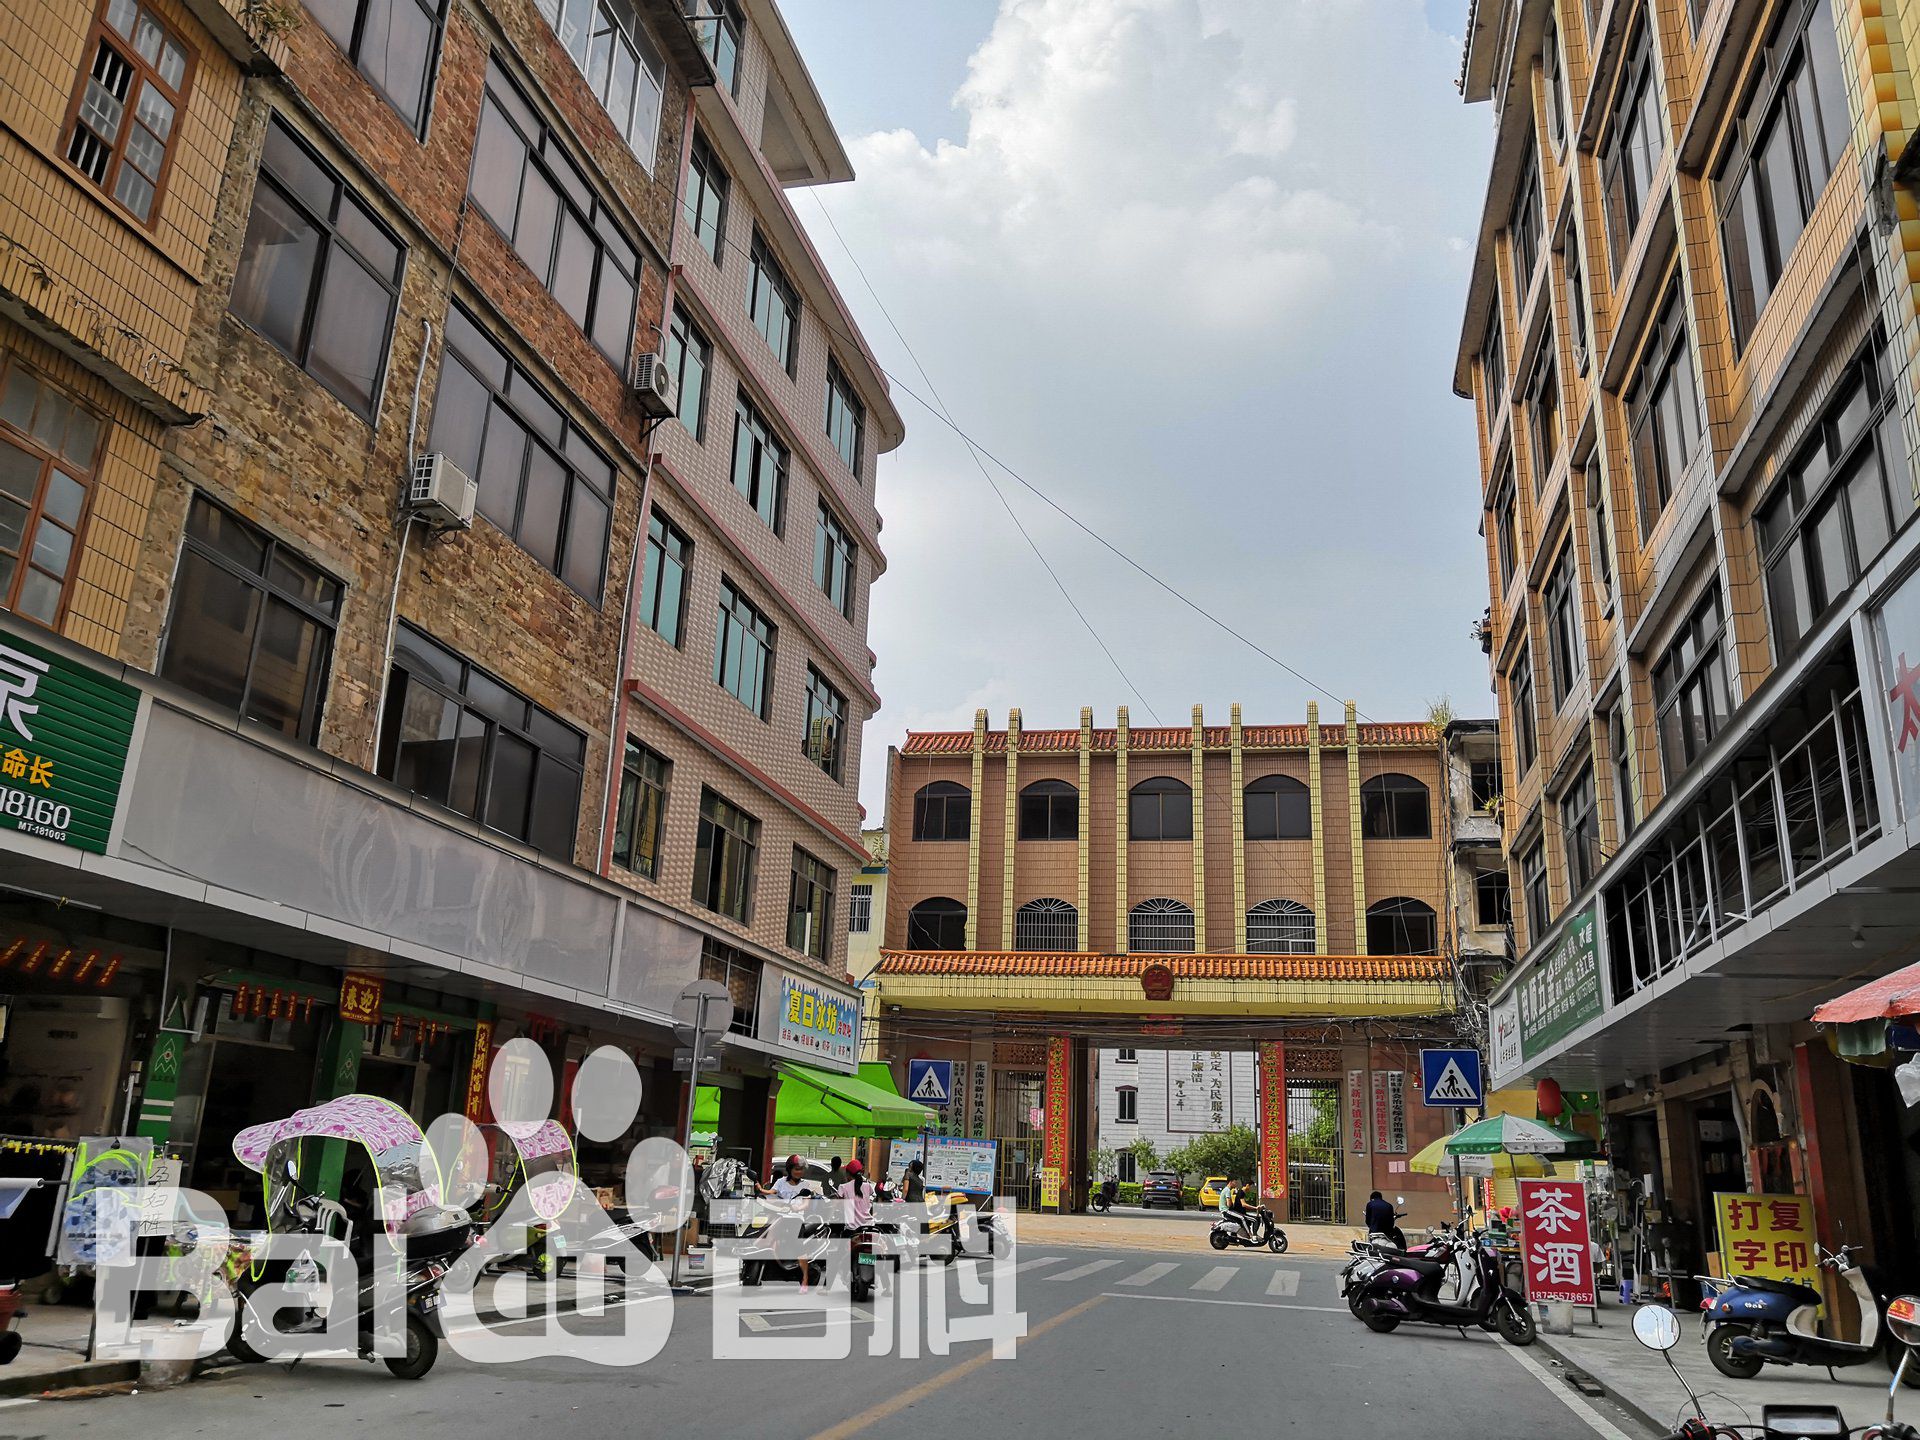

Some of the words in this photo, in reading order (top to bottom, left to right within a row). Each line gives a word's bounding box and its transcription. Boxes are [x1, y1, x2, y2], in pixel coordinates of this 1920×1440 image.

[18, 820, 67, 841] MT-181003
[789, 989, 838, 1035] 夏日冰坊
[953, 1077, 963, 1137] 人民代表大会
[1525, 1188, 1584, 1286] 茶酒
